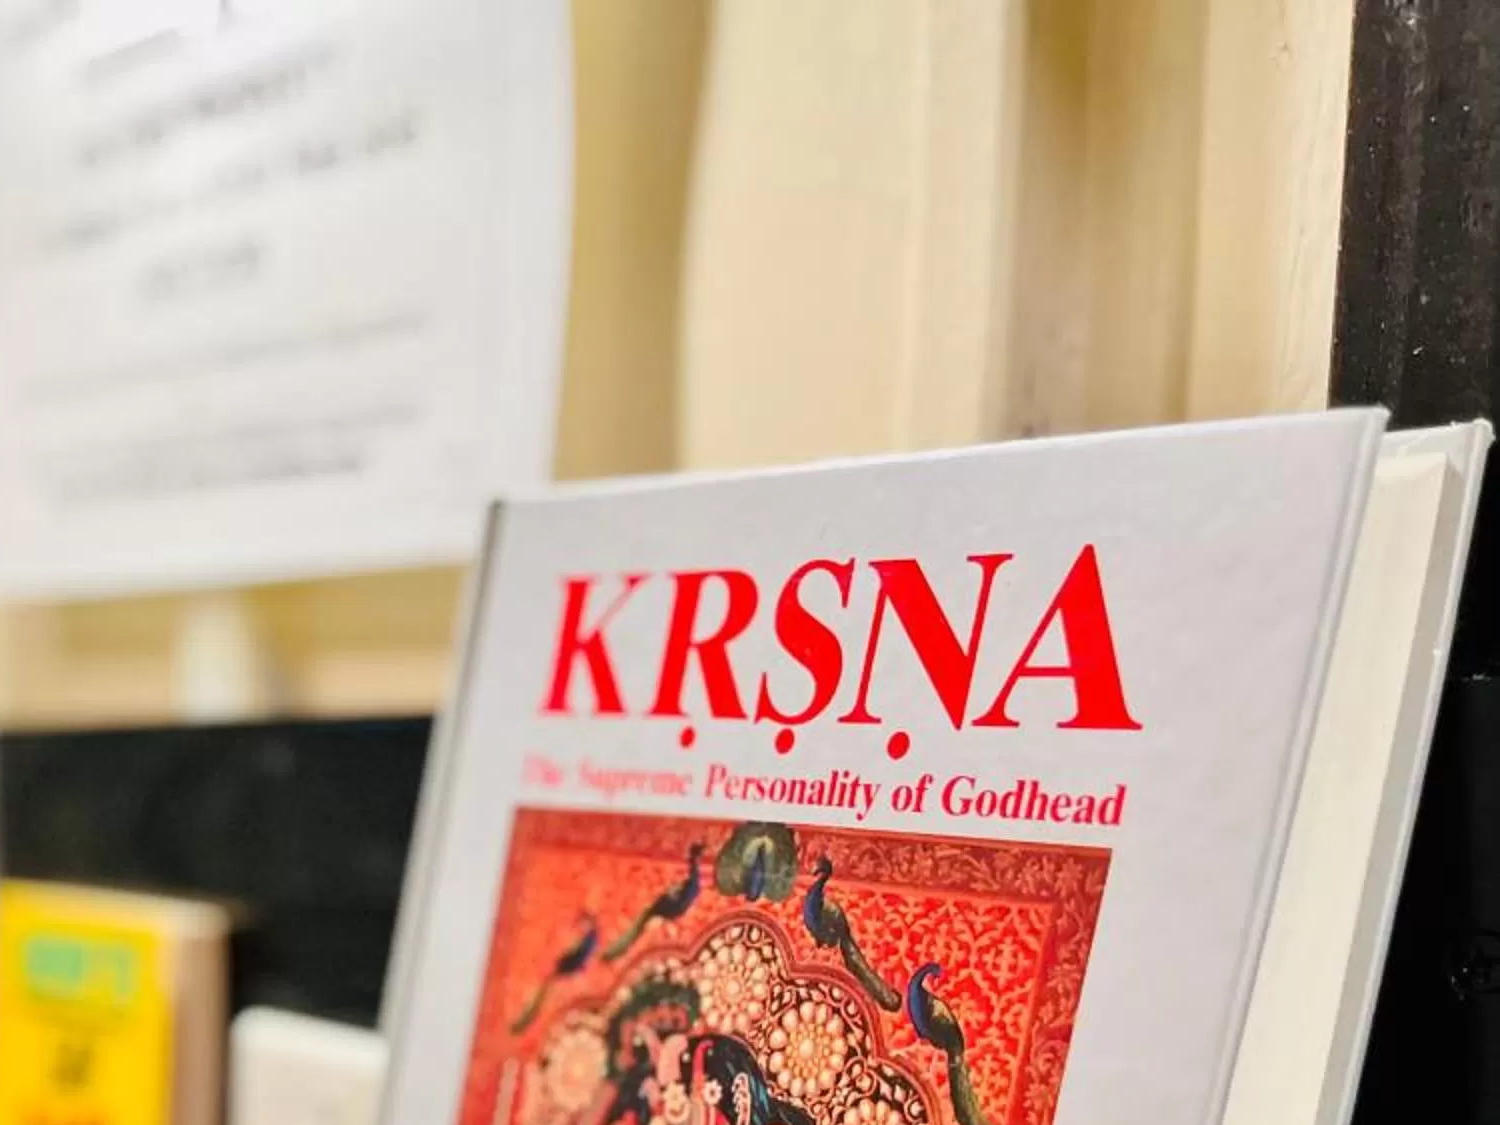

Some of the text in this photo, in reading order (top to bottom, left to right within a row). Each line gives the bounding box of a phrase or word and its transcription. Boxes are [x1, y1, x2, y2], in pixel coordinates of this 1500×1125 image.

[703, 762, 881, 822] Personality
[890, 772, 936, 815] of
[940, 773, 1129, 828] Godhead
